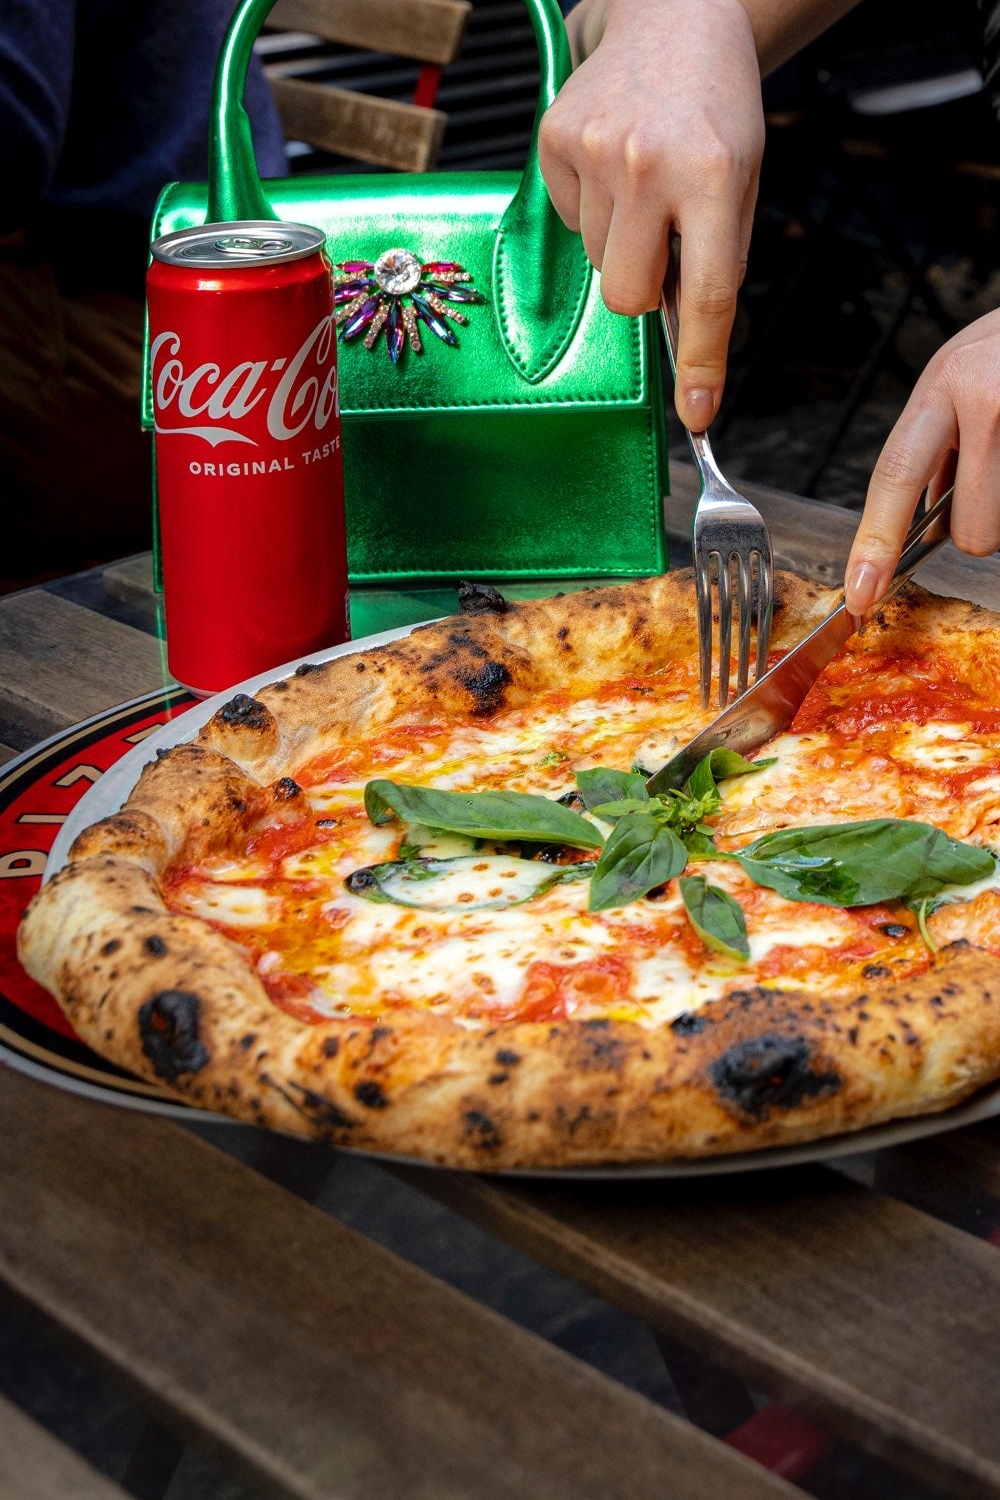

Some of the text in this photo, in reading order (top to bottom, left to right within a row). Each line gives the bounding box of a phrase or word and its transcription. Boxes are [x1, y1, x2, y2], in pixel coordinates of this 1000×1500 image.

[150, 314, 341, 448] Coca-Co
[189, 435, 342, 477] ORIGINAL TASTE
